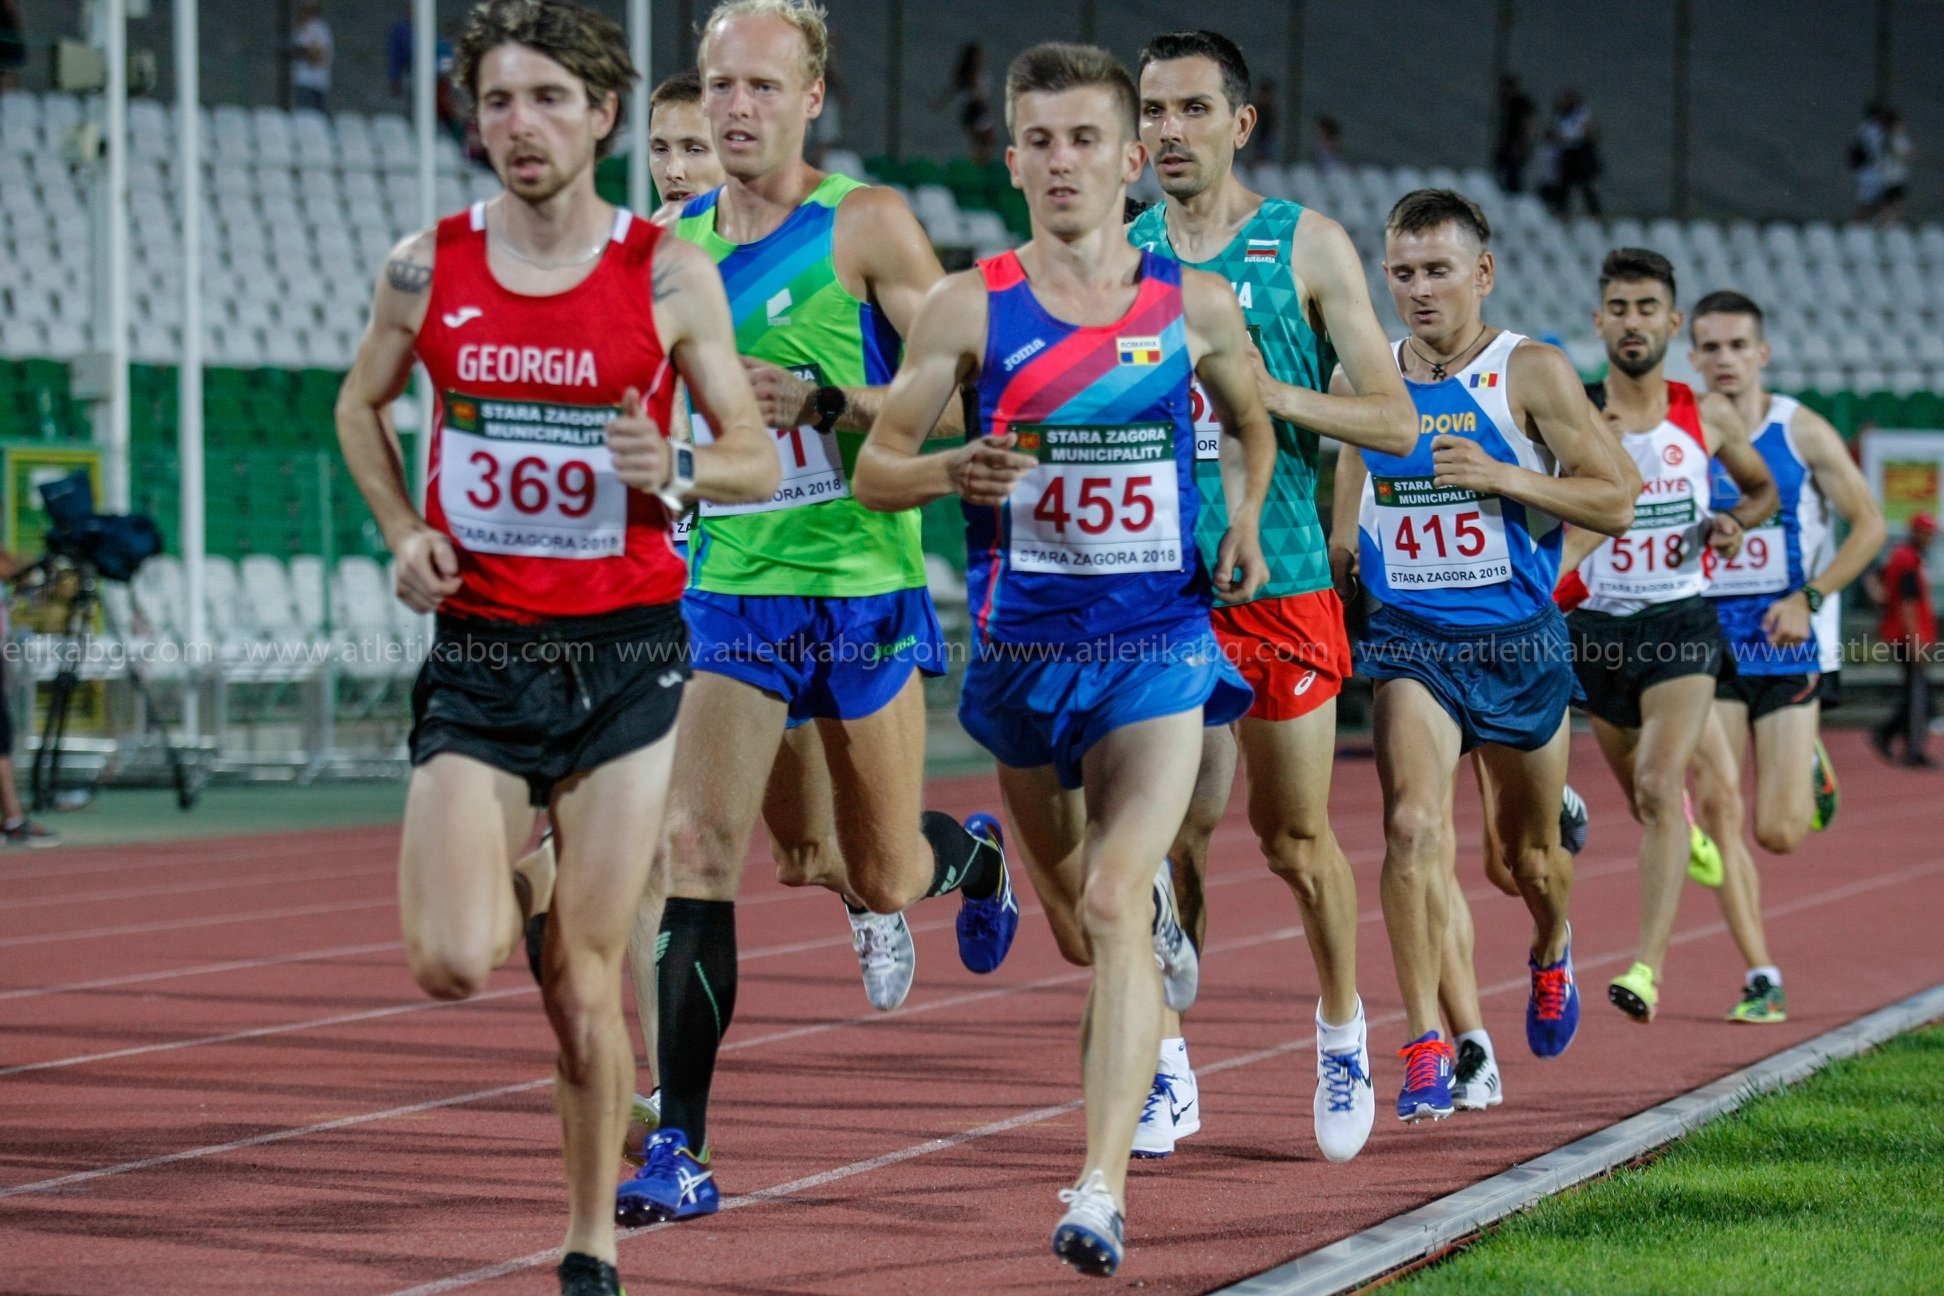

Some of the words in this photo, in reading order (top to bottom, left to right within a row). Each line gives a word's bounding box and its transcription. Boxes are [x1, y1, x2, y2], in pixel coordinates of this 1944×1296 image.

[457, 344, 598, 387] GEORGIA
[481, 403, 541, 421] STARA
[544, 406, 618, 426] ZAGORA
[1046, 431, 1102, 444] STARA
[1105, 428, 1167, 443] ZAGORA
[1052, 445, 1164, 461] MUNICIPALITY
[467, 451, 596, 518] 369
[809, 478, 842, 496] 2018
[1394, 480, 1432, 492] STARA
[1034, 476, 1154, 535] 455
[1399, 489, 1485, 505] MUNICIPALIT
[504, 532, 576, 549] ZAGORA
[1395, 511, 1486, 560] 415
[1020, 550, 1069, 565] STARA
[1073, 551, 1138, 566] ZAGORA
[1142, 549, 1176, 563] 2018
[1610, 533, 1684, 574] 518
[1391, 572, 1425, 583] STARA
[1427, 570, 1477, 582] ZAGORA
[1480, 565, 1508, 579] 2018
